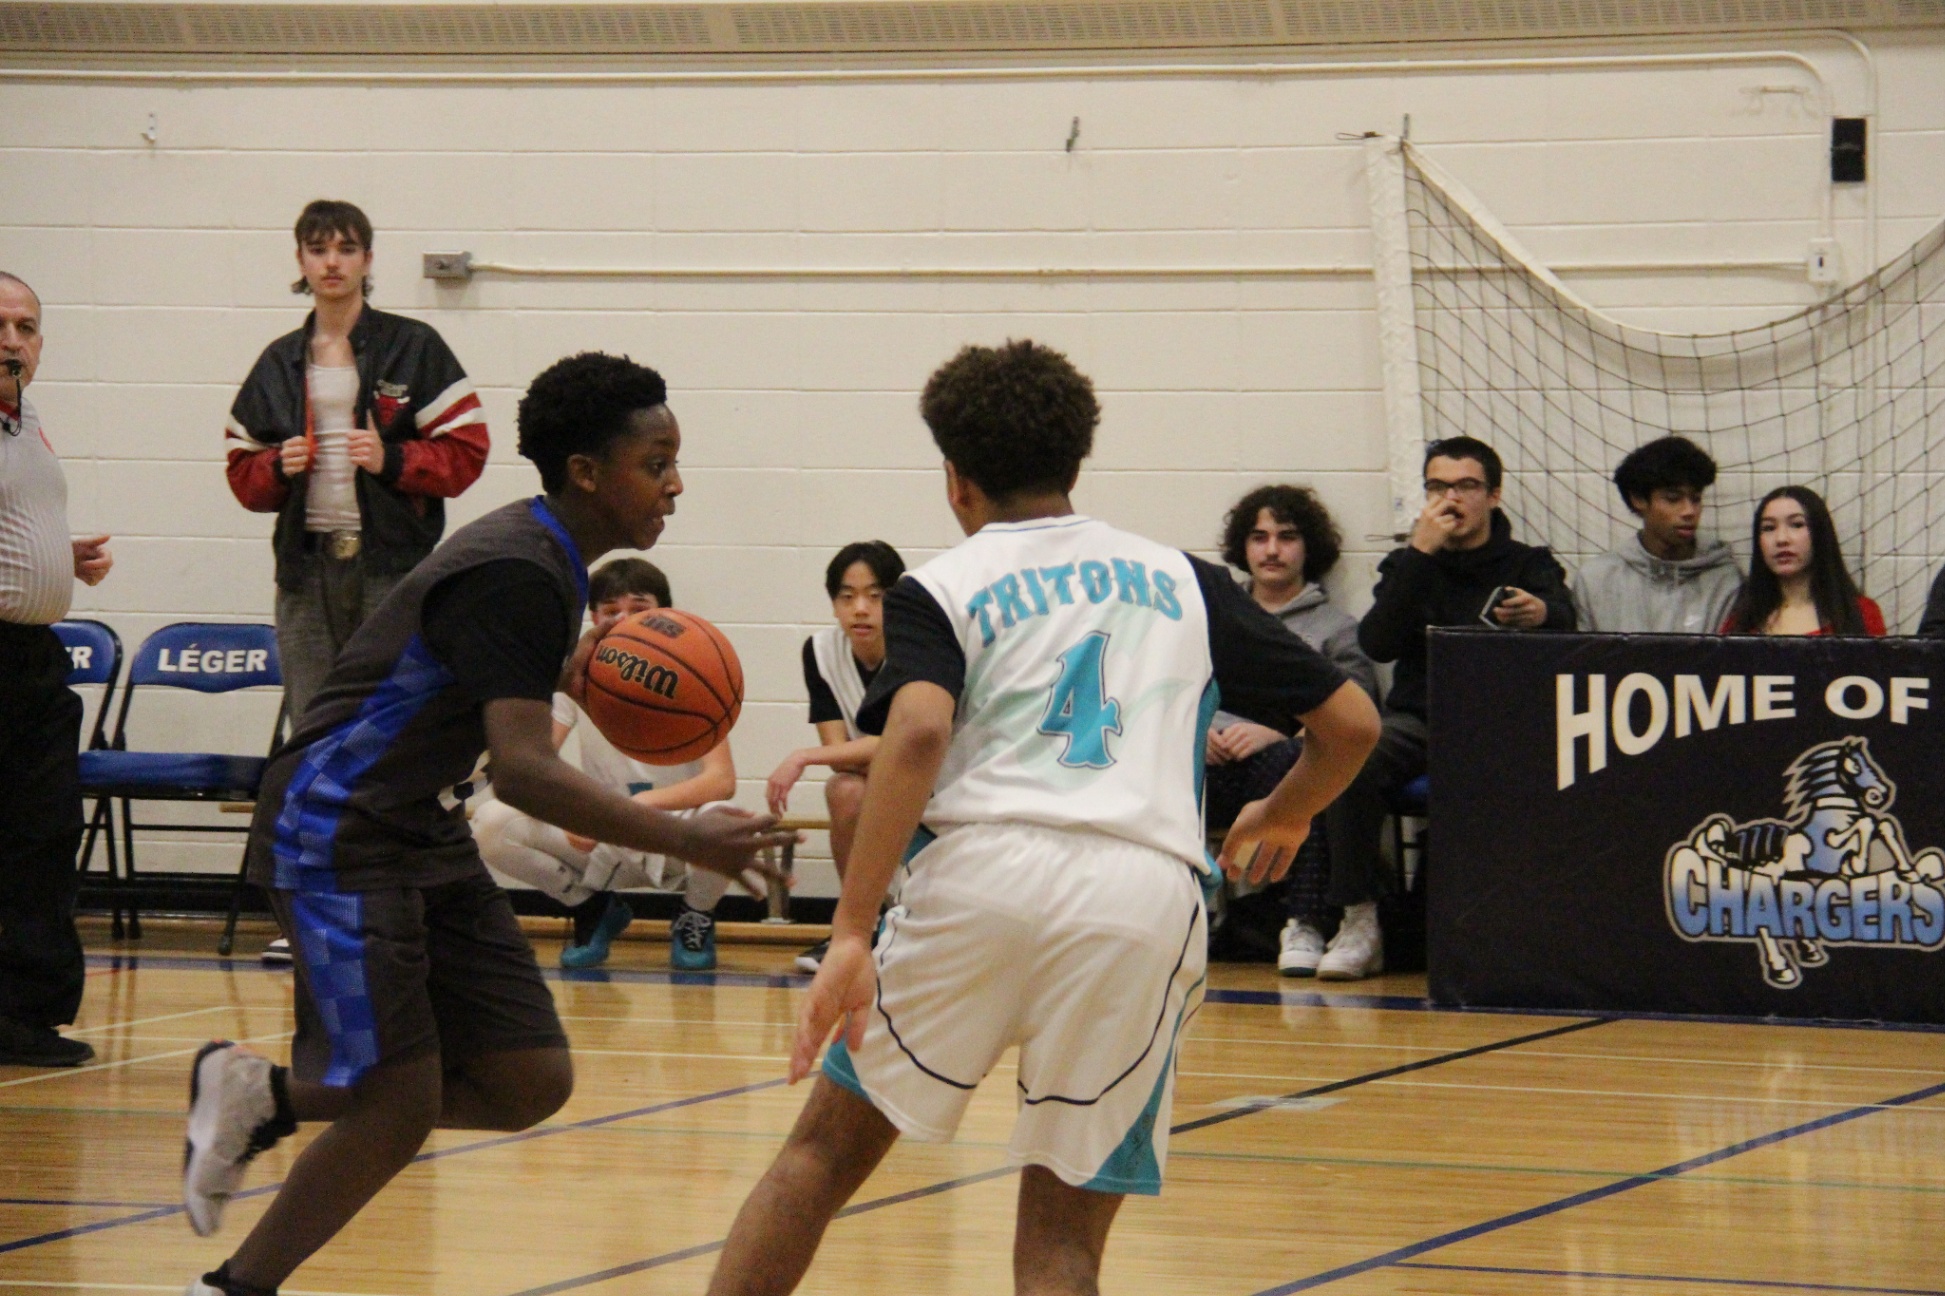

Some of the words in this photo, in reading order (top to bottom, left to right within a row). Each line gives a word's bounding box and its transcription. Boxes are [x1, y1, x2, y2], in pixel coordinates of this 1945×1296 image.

[965, 557, 1183, 648] TRITONS
[157, 642, 268, 673] LÉGER
[597, 646, 679, 700] Wilson
[1036, 629, 1123, 770] 4
[1555, 672, 1797, 792] HOME
[1824, 675, 1931, 725] OF
[1669, 847, 1945, 945] CHARGERS
